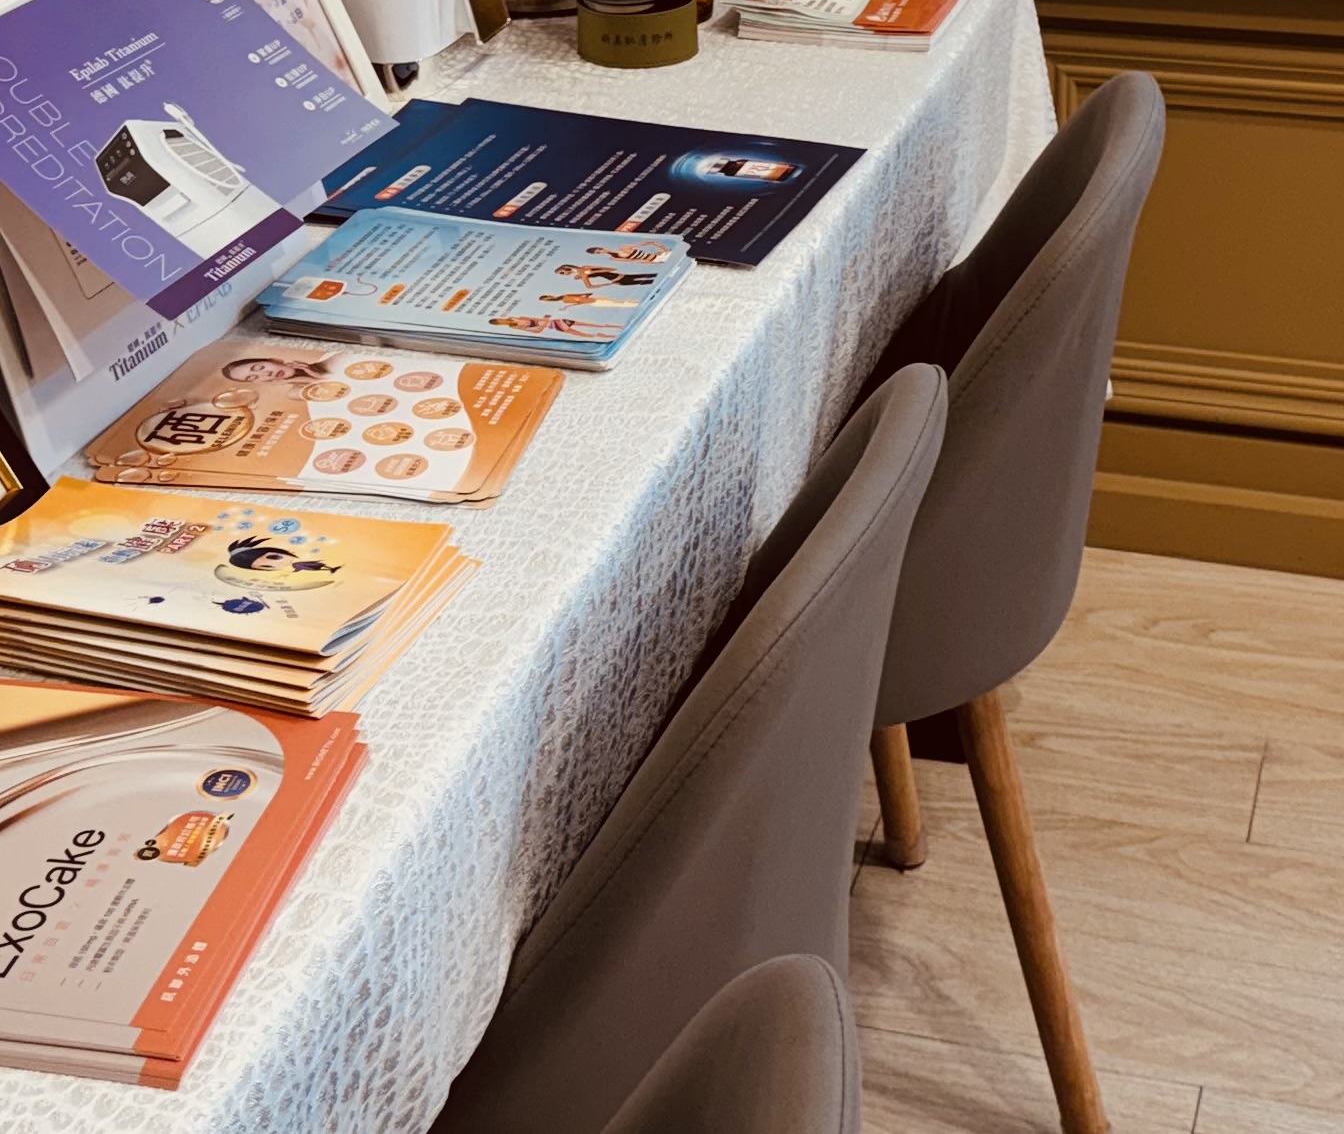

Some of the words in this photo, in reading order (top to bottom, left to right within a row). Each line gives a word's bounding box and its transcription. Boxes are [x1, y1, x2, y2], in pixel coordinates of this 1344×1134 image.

[69, 52, 107, 83] Epilab
[105, 30, 159, 65] Titanium
[204, 246, 257, 283] Titanium
[144, 410, 232, 445] 硒
[210, 415, 244, 449] SELENIUM
[157, 531, 197, 554] PART
